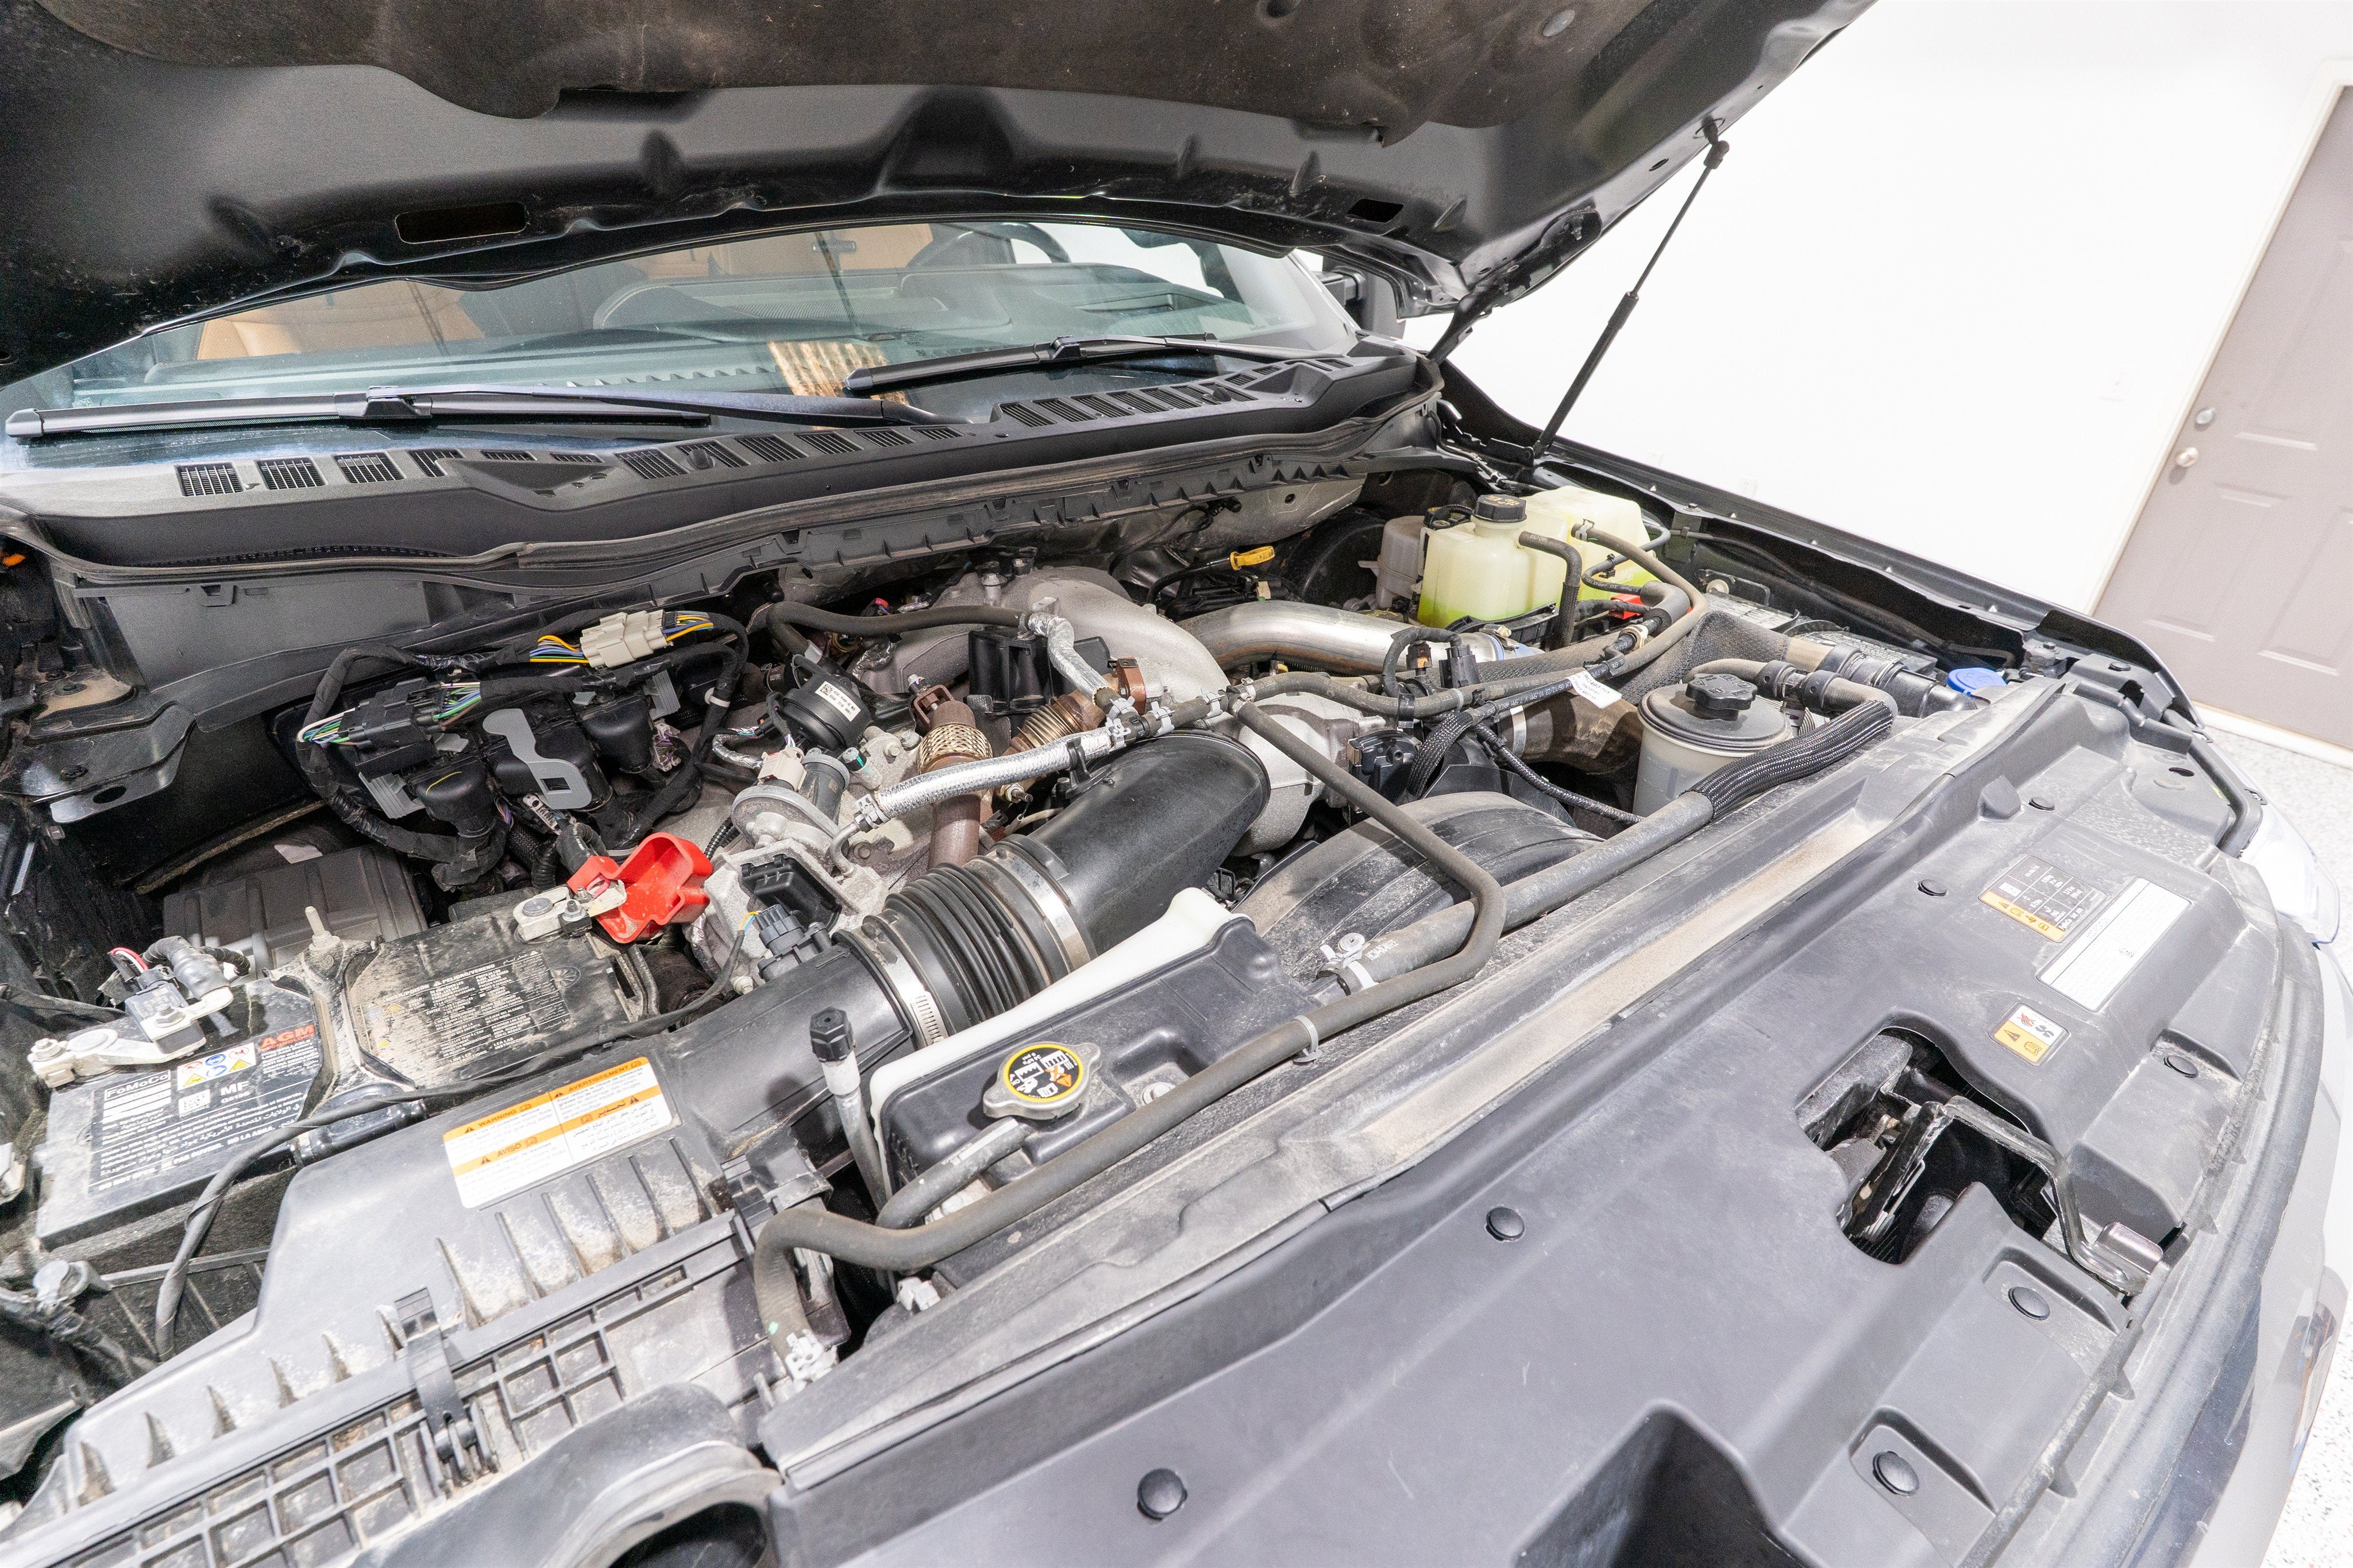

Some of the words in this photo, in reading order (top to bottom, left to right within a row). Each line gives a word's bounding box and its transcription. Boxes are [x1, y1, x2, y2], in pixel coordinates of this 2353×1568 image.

[260, 1025, 314, 1048] AGM
[107, 1073, 169, 1098] FoMoCo
[219, 1080, 250, 1095] MF
[568, 1065, 629, 1092] AVERTISSEMENT
[478, 1109, 517, 1127] WARNING
[496, 1142, 522, 1157] AVISO
